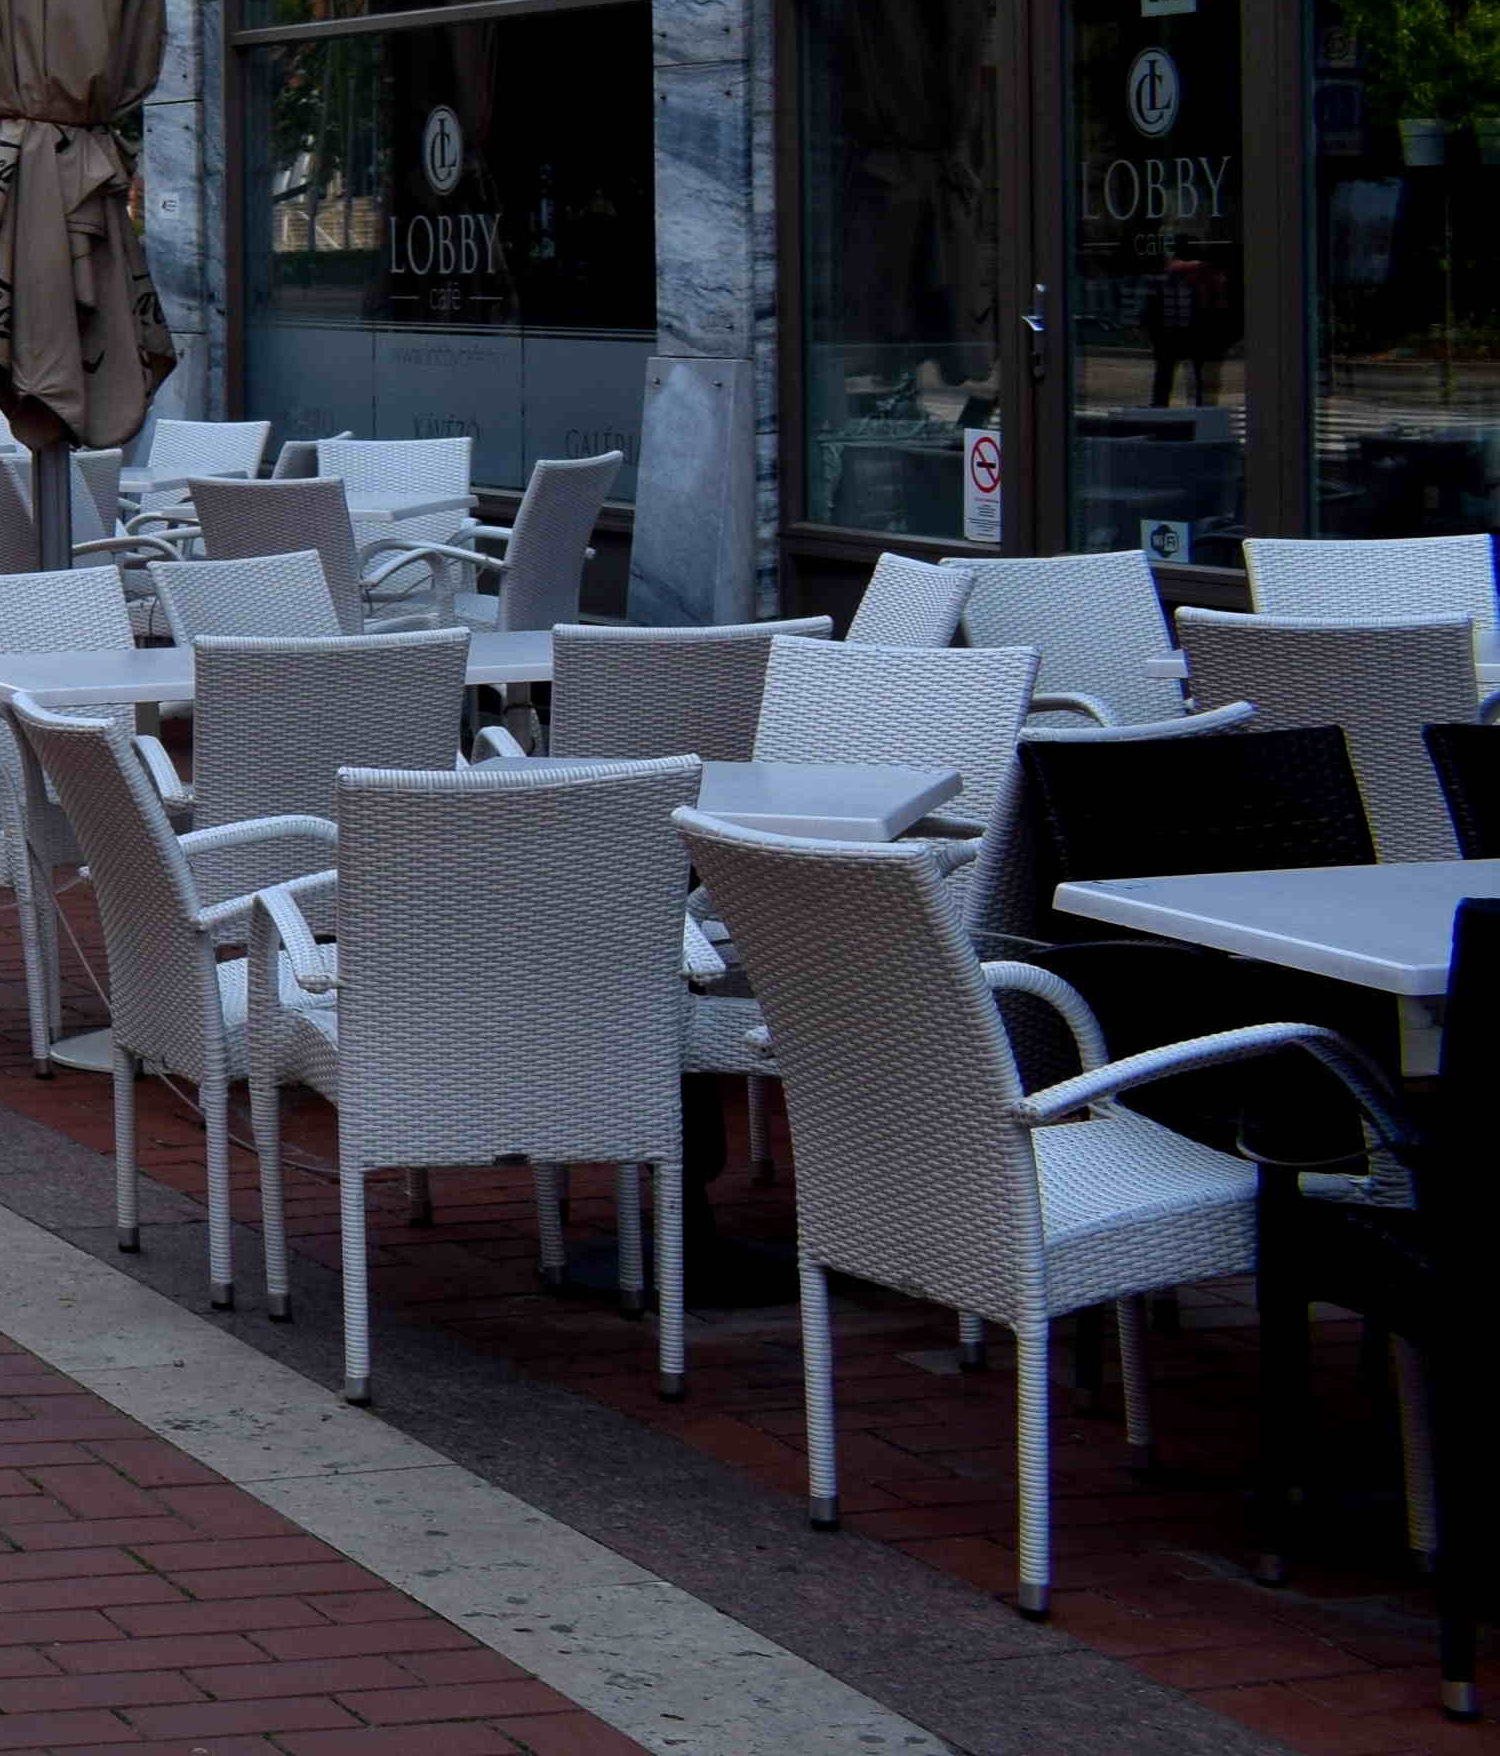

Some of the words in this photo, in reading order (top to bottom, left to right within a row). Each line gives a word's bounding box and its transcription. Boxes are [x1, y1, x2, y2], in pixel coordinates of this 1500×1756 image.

[1082, 156, 1232, 221] LOBBY
[388, 213, 503, 277] LOBBY
[428, 280, 462, 311] café
